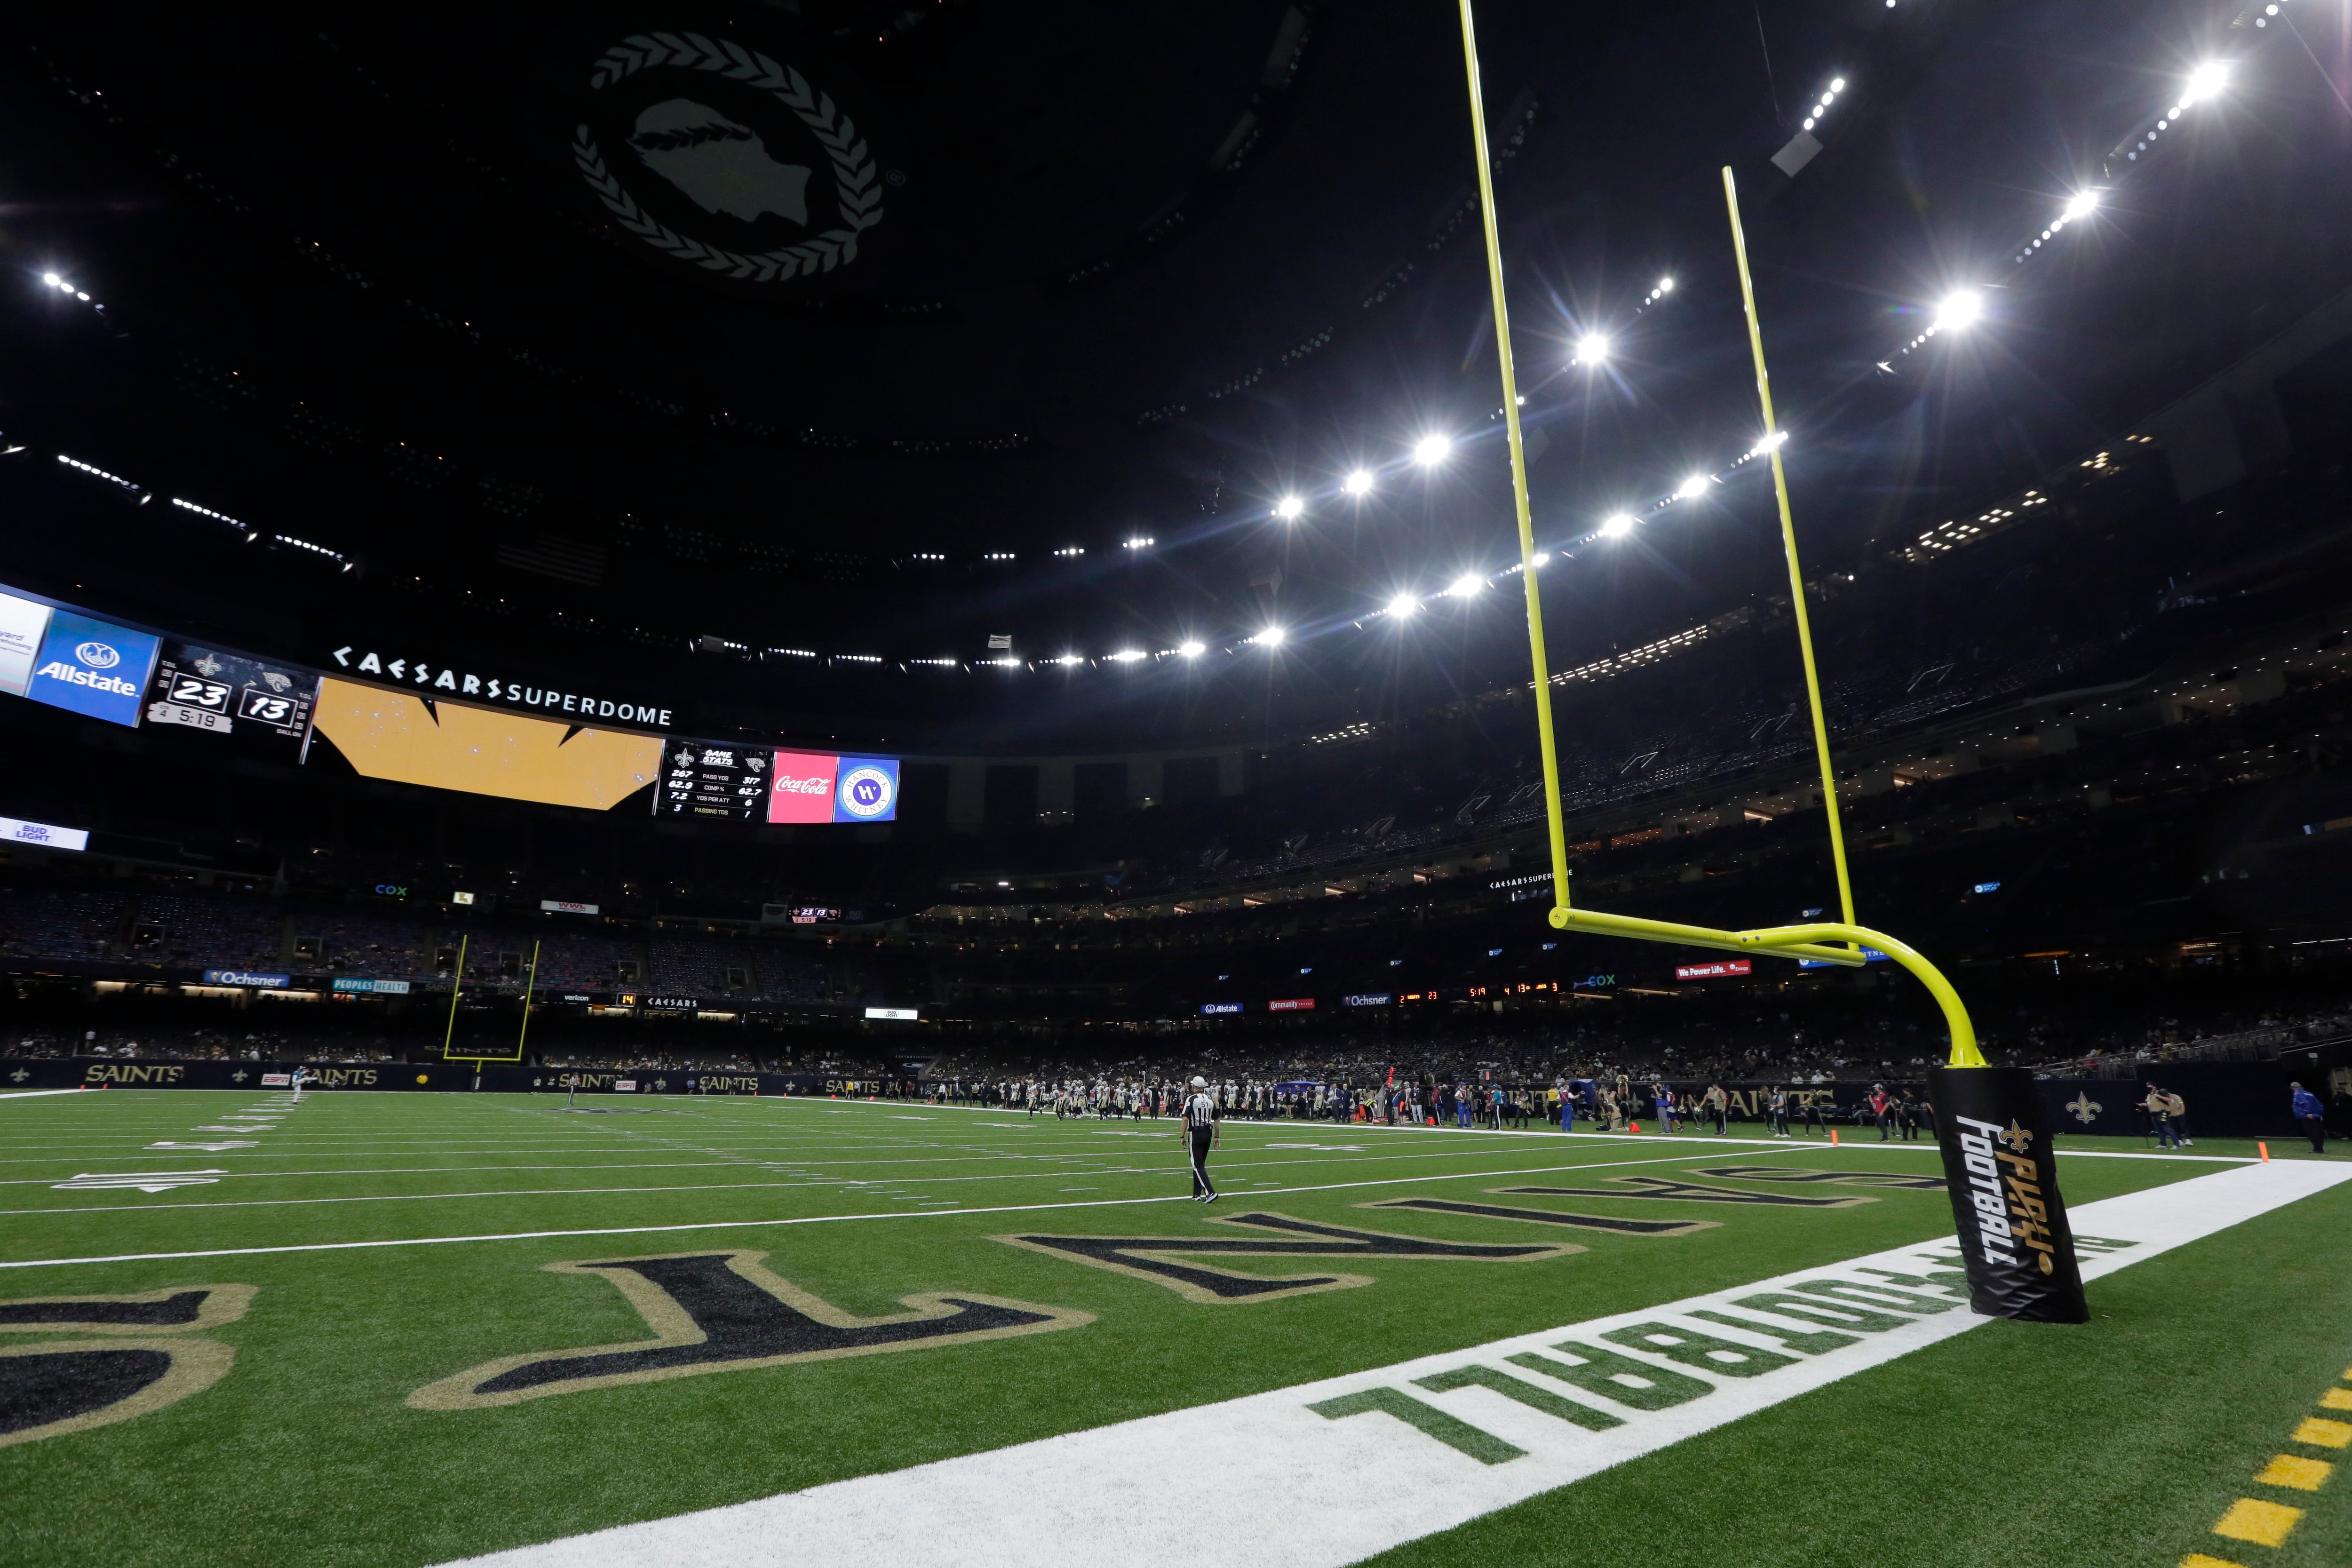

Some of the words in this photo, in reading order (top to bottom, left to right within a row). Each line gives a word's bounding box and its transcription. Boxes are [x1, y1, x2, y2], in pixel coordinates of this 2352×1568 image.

[333, 646, 501, 699] CAESARS
[507, 685, 672, 726] SUPERDOME
[173, 681, 228, 705] 23
[249, 697, 290, 719] 13
[179, 709, 215, 727] 5:19
[705, 749, 733, 758] GAME
[702, 756, 733, 765] STATS
[671, 769, 693, 779] 267
[742, 776, 761, 785] 317
[845, 771, 890, 789] HANCOCK
[668, 780, 693, 790] 62.9
[738, 788, 762, 796] 62.7
[775, 775, 832, 795] Coca-Cola
[670, 791, 688, 801] 7.2
[673, 804, 682, 812] 3
[844, 796, 889, 814] WHITNEY
[16, 830, 51, 842] LIGHT
[23, 825, 47, 834] BUD
[1490, 877, 1527, 889] CAESARS
[375, 884, 408, 896] COX
[1678, 968, 1689, 977] We
[1689, 967, 1710, 976] Power
[221, 971, 283, 987] Ochsner
[334, 979, 373, 990] PEOPLES
[375, 980, 408, 992] HEALTH
[1589, 974, 1616, 987] COX
[1428, 991, 1437, 1000] 23
[1470, 988, 1486, 996] 5:19
[1552, 983, 1557, 992] 3
[622, 995, 633, 1004] 14
[648, 998, 697, 1008] CAESARS
[1271, 1001, 1298, 1010] Community
[1351, 995, 1387, 1006] Ochsner
[85, 1065, 184, 1082] SAINTS
[1956, 1114, 2017, 1265] FOOTBALL
[1994, 1150, 2054, 1254] PLAY
